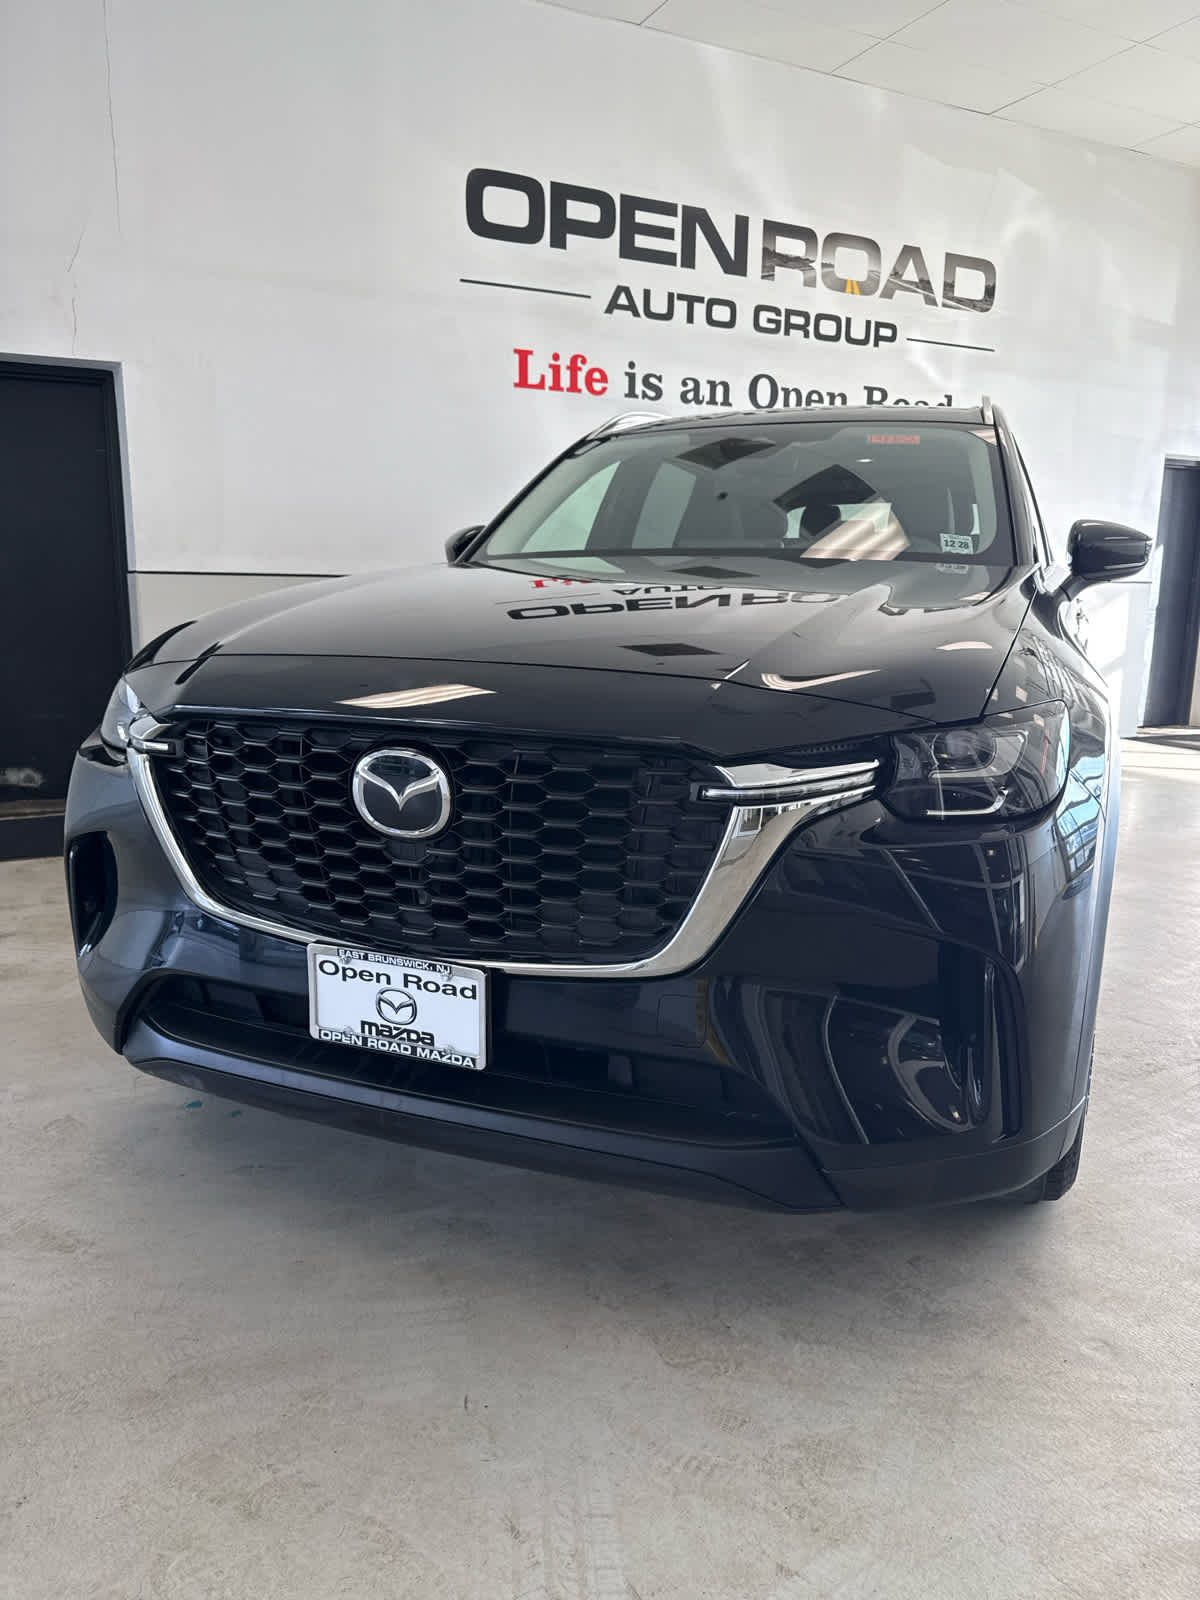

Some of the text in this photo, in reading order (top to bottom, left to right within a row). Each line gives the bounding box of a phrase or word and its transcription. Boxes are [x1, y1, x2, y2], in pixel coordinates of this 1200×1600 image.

[465, 168, 997, 314] OPEN ROAD
[603, 285, 898, 348] AUTO GROUP
[513, 348, 609, 396] Life
[624, 361, 664, 402] is
[679, 376, 732, 407] an
[943, 539, 956, 548] 12
[318, 960, 477, 1000] Open Road
[338, 949, 451, 974] EAST BRUNSWICK, NJ
[319, 1030, 475, 1068] OPEN ROAD MAZDA
